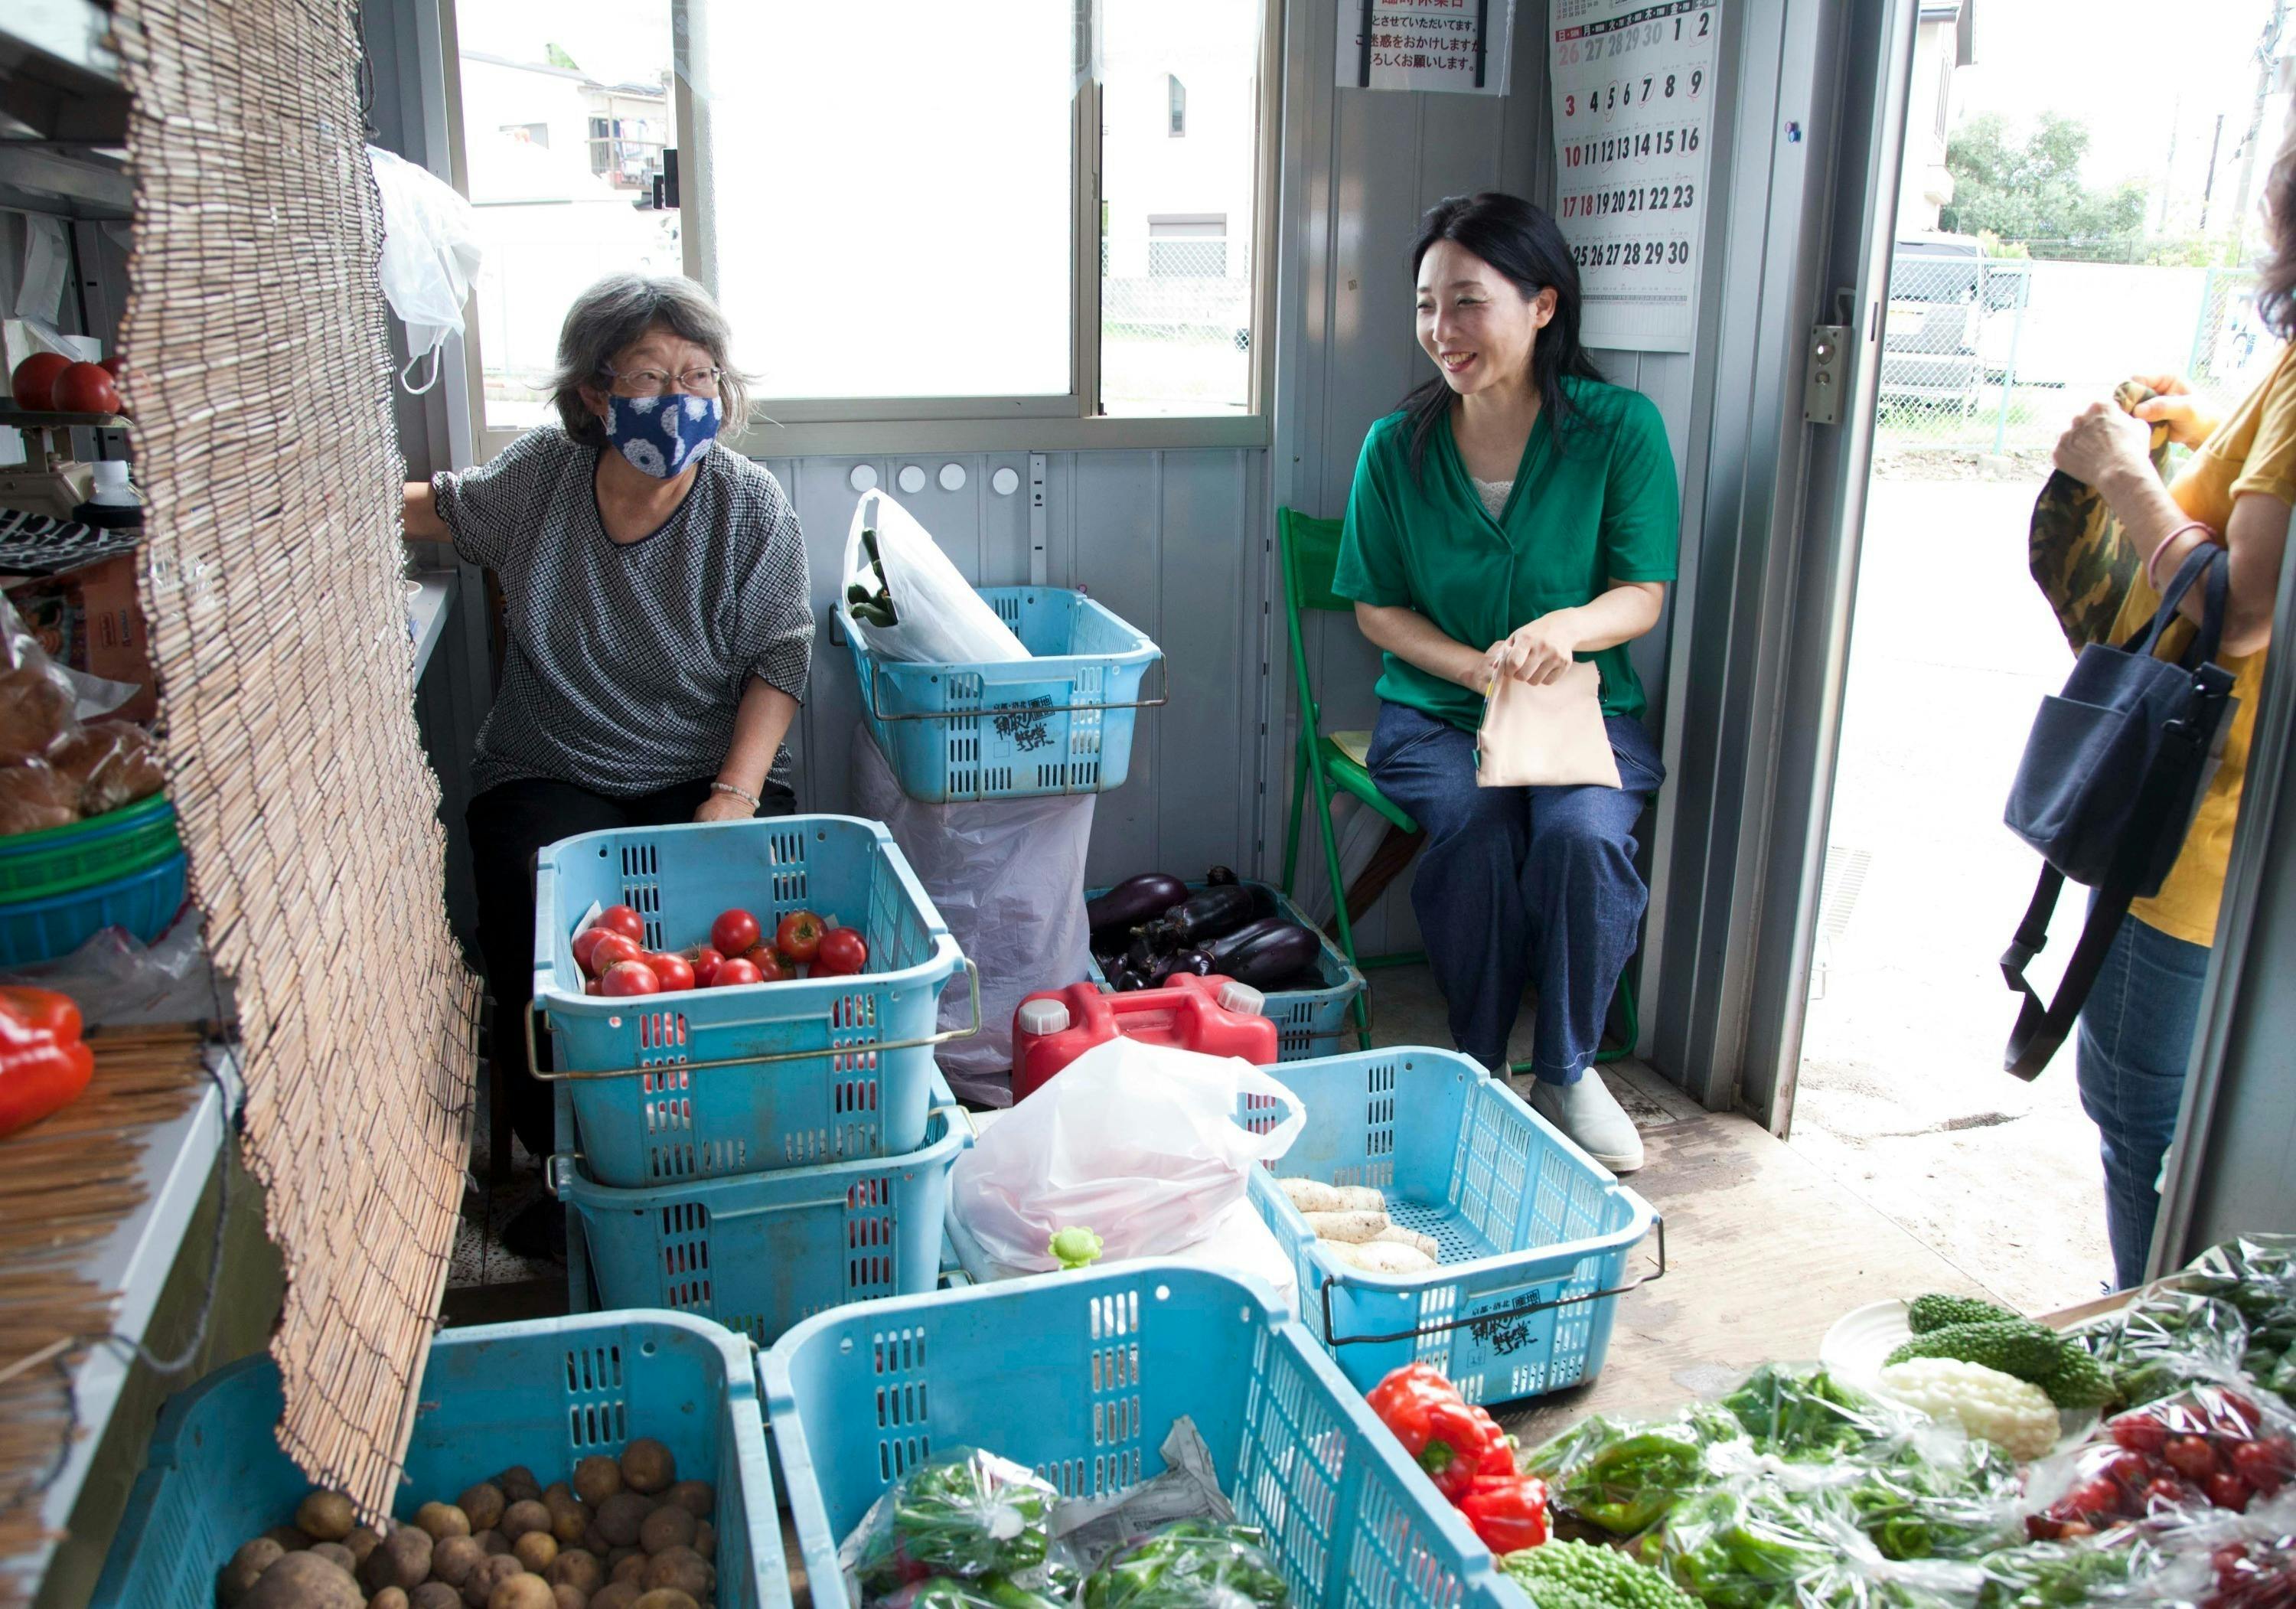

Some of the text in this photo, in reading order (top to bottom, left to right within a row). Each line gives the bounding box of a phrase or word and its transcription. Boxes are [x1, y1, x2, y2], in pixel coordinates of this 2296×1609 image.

[1373, 15, 1476, 32] とさせていただいてます。
[1558, 12, 1710, 66] 26 27 28 29 30 1 2
[1370, 53, 1474, 71] ろしくお願いします。
[1565, 70, 1702, 116] 3 4 5 6 7 8 9
[1565, 127, 1699, 168] 10 11 12 13 14 15 16
[1563, 184, 1694, 217] 17 18 19 20 21 22 23
[1574, 241, 1689, 266] 25 26 27 28 29 30
